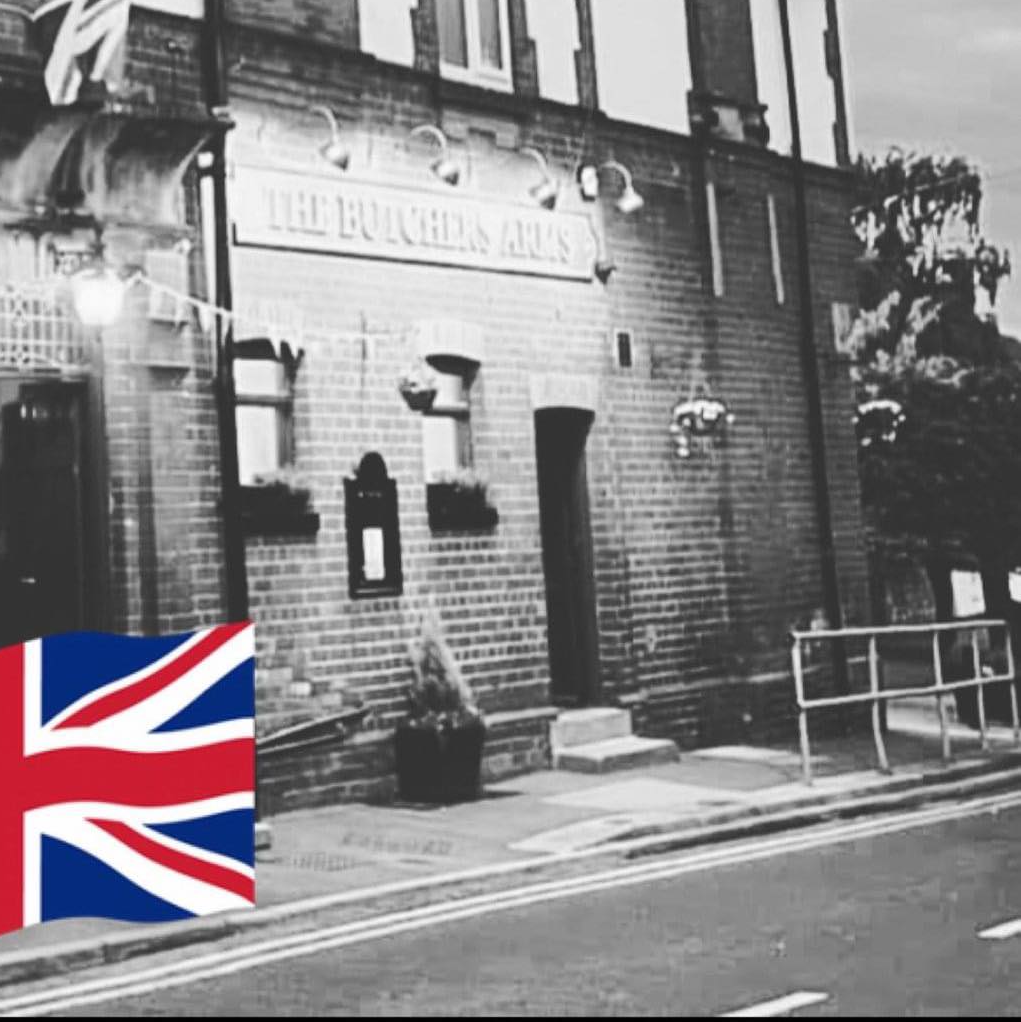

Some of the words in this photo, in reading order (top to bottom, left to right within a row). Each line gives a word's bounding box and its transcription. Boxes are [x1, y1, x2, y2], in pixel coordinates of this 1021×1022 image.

[264, 184, 330, 236] THE
[336, 193, 490, 255] BUTCHERS
[499, 218, 575, 266] ARMS
